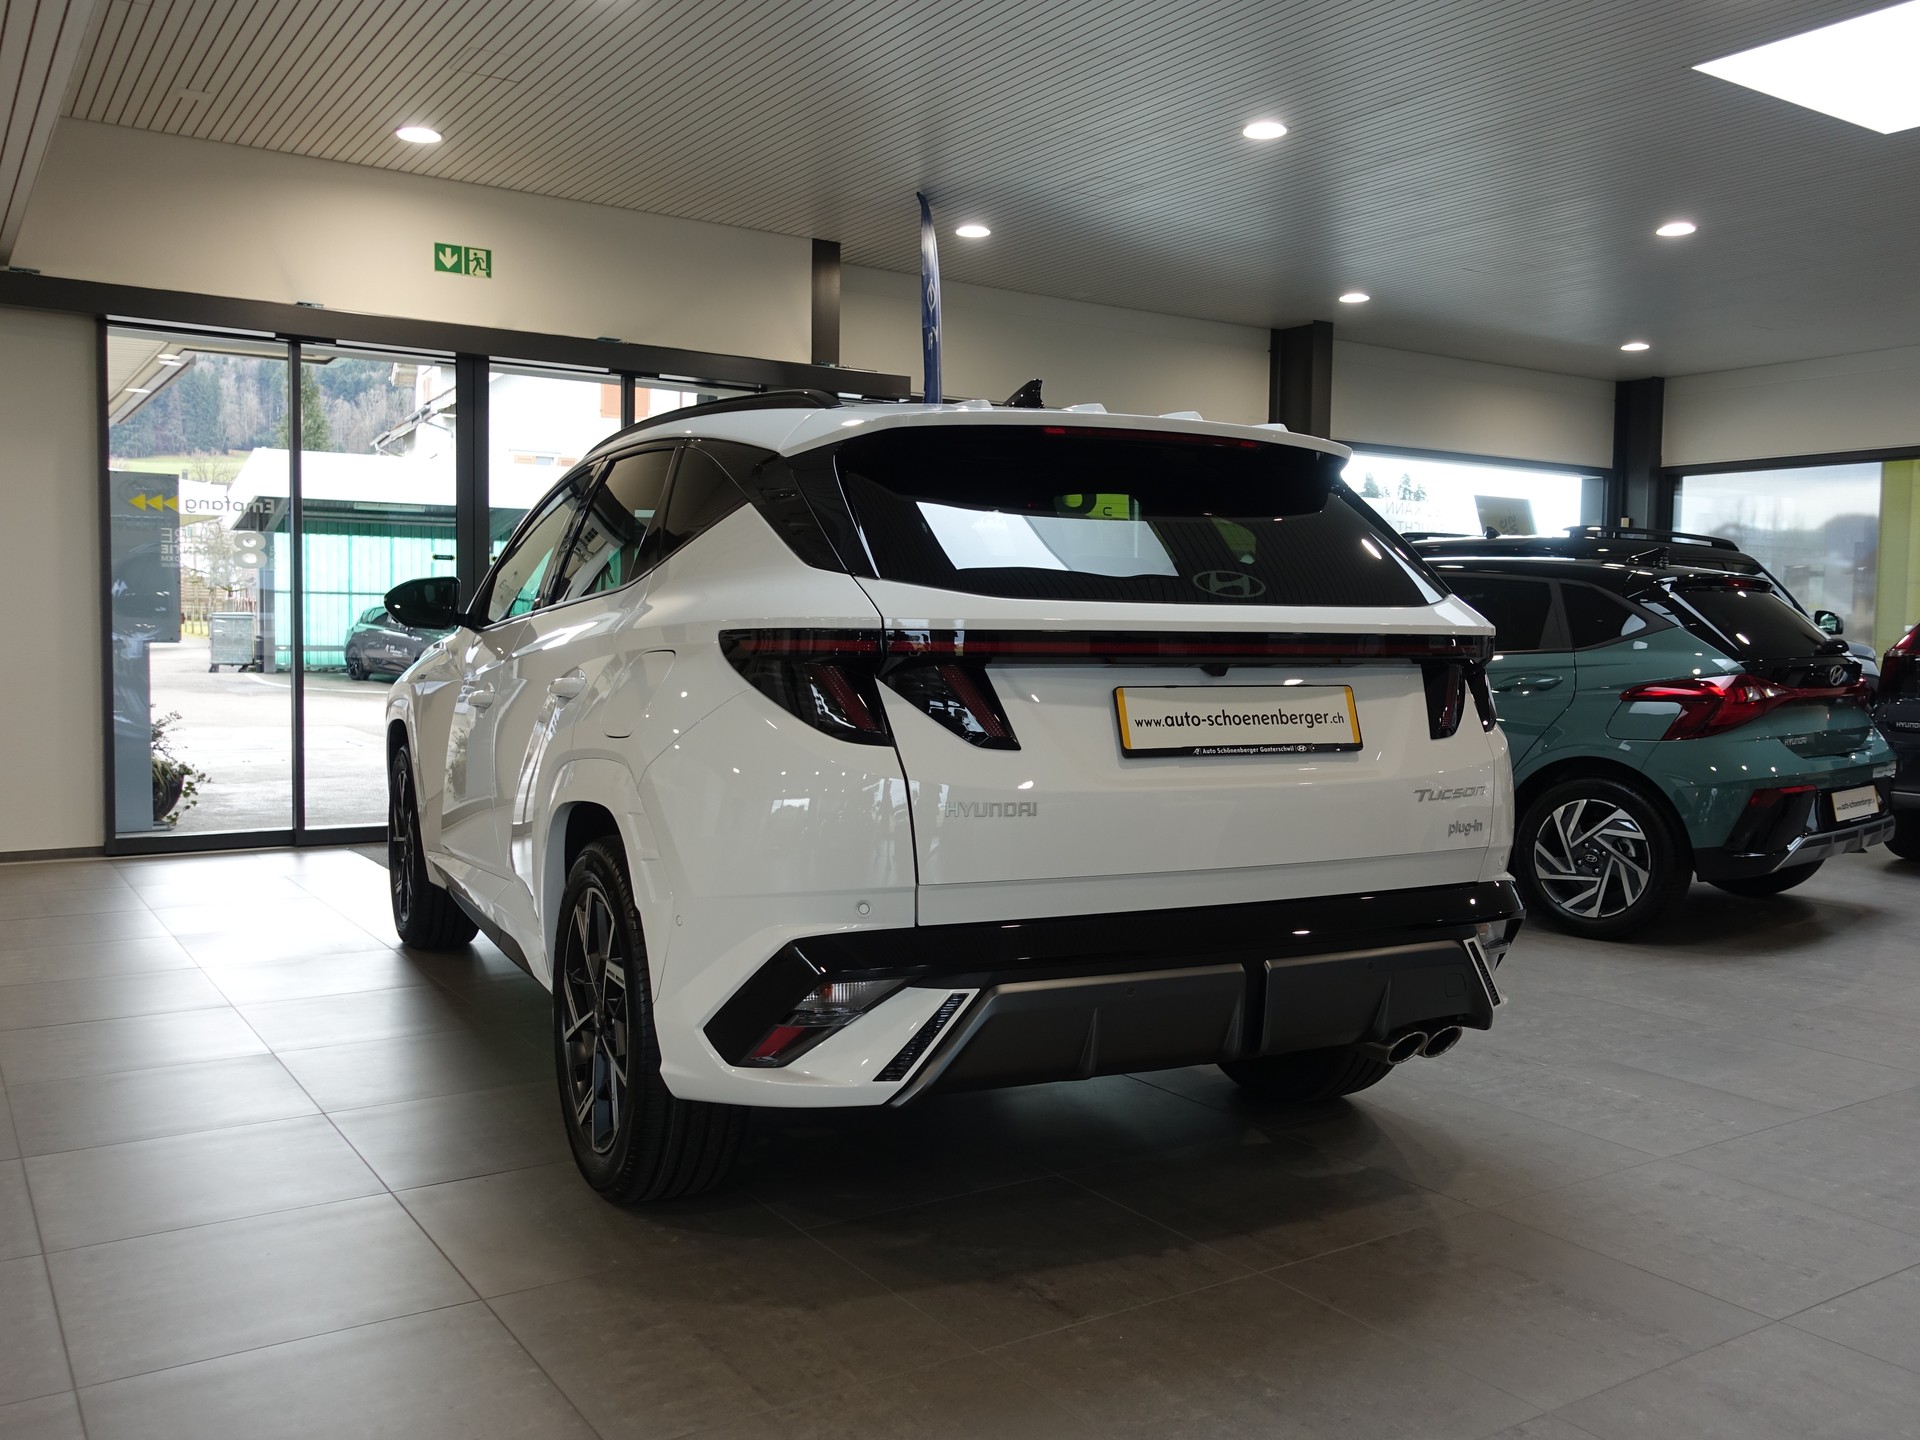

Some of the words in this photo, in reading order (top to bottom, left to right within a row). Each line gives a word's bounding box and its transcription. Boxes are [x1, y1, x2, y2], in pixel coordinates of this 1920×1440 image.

[1135, 709, 1345, 729] www.auto-schoenenberger.ch
[1895, 721, 1920, 729] HYUND
[1217, 746, 1259, 755] Schönenberger
[945, 801, 1038, 818] HYUNDAI
[1448, 819, 1483, 837] plug-in
